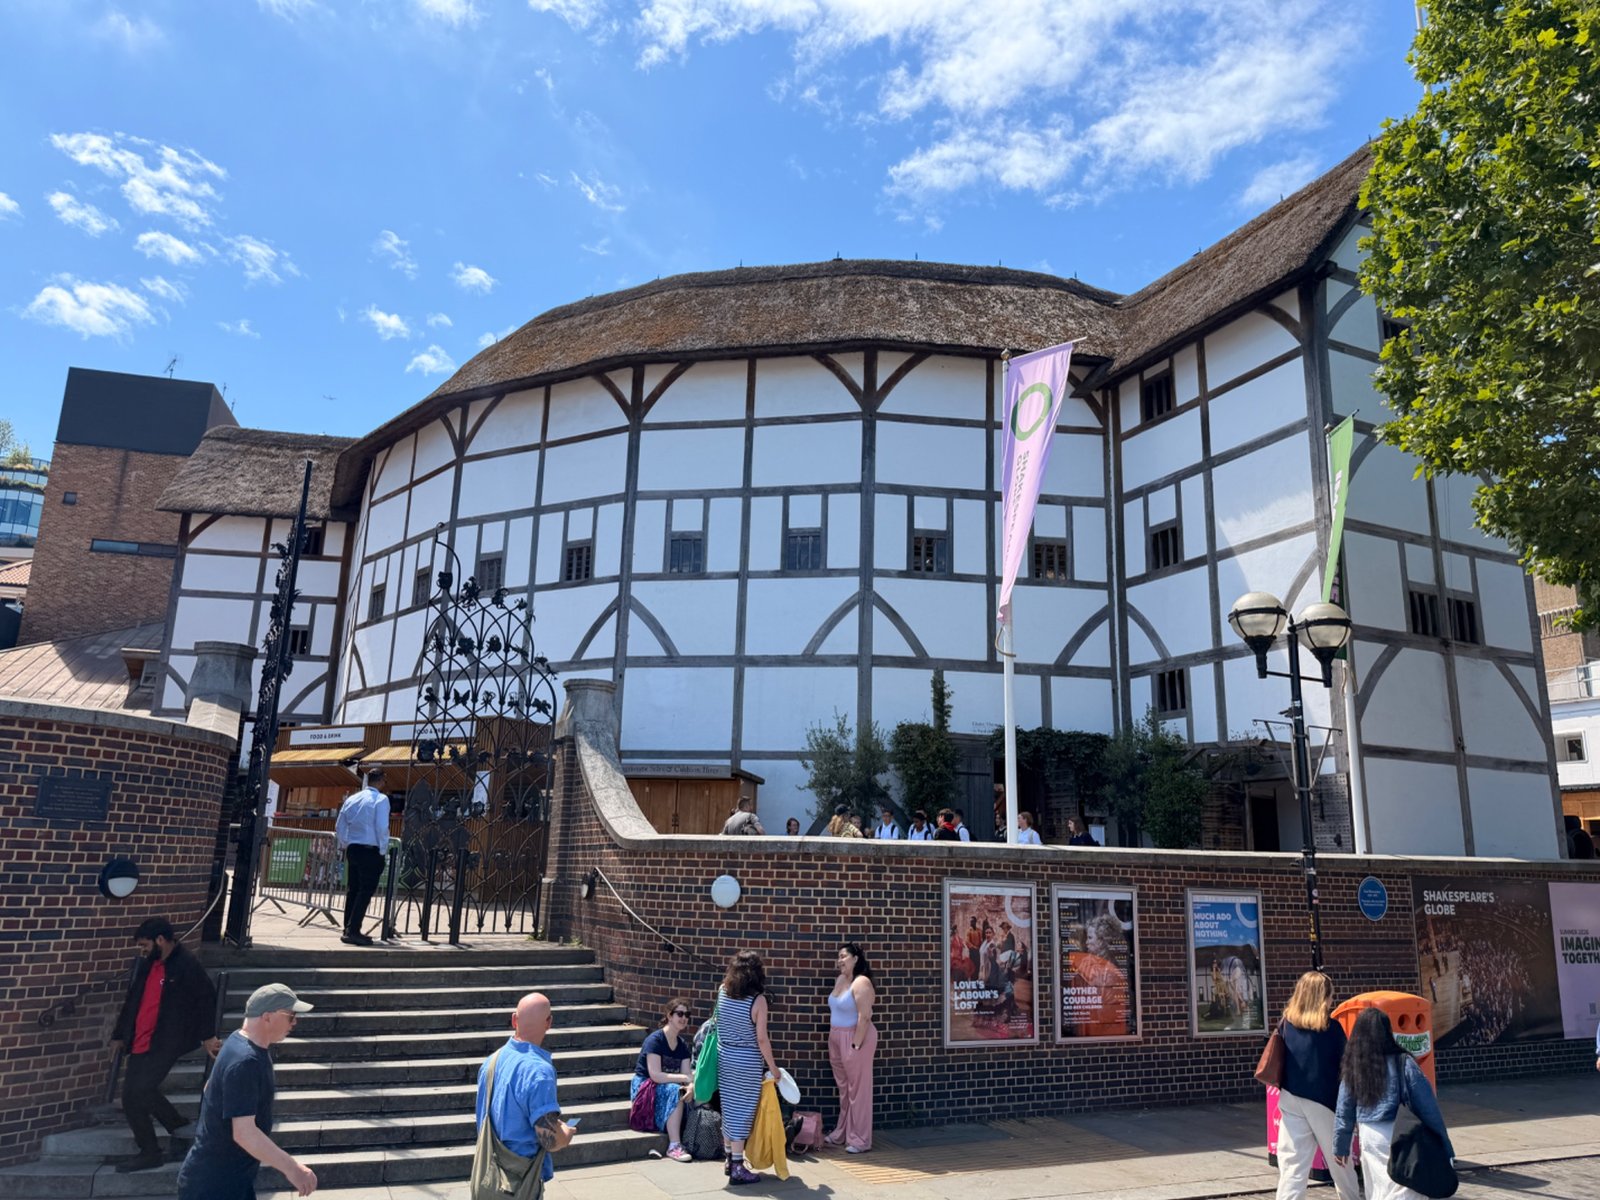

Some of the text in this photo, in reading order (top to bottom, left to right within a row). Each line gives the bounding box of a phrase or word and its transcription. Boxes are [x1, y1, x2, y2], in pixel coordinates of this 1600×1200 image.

[1423, 890, 1495, 903] SHAKESPEARE'S
[1424, 903, 1456, 915] GLOBE
[1193, 912, 1232, 920] MUCH ADO
[1194, 921, 1219, 929] ABOUT
[1195, 930, 1228, 938] NOTHING
[954, 980, 985, 990] LOVE'S
[954, 990, 999, 1000] LABOUR'S
[1063, 986, 1098, 995] MOTHER
[1063, 995, 1103, 1004] COURAGE
[954, 1000, 978, 1010] LOST
